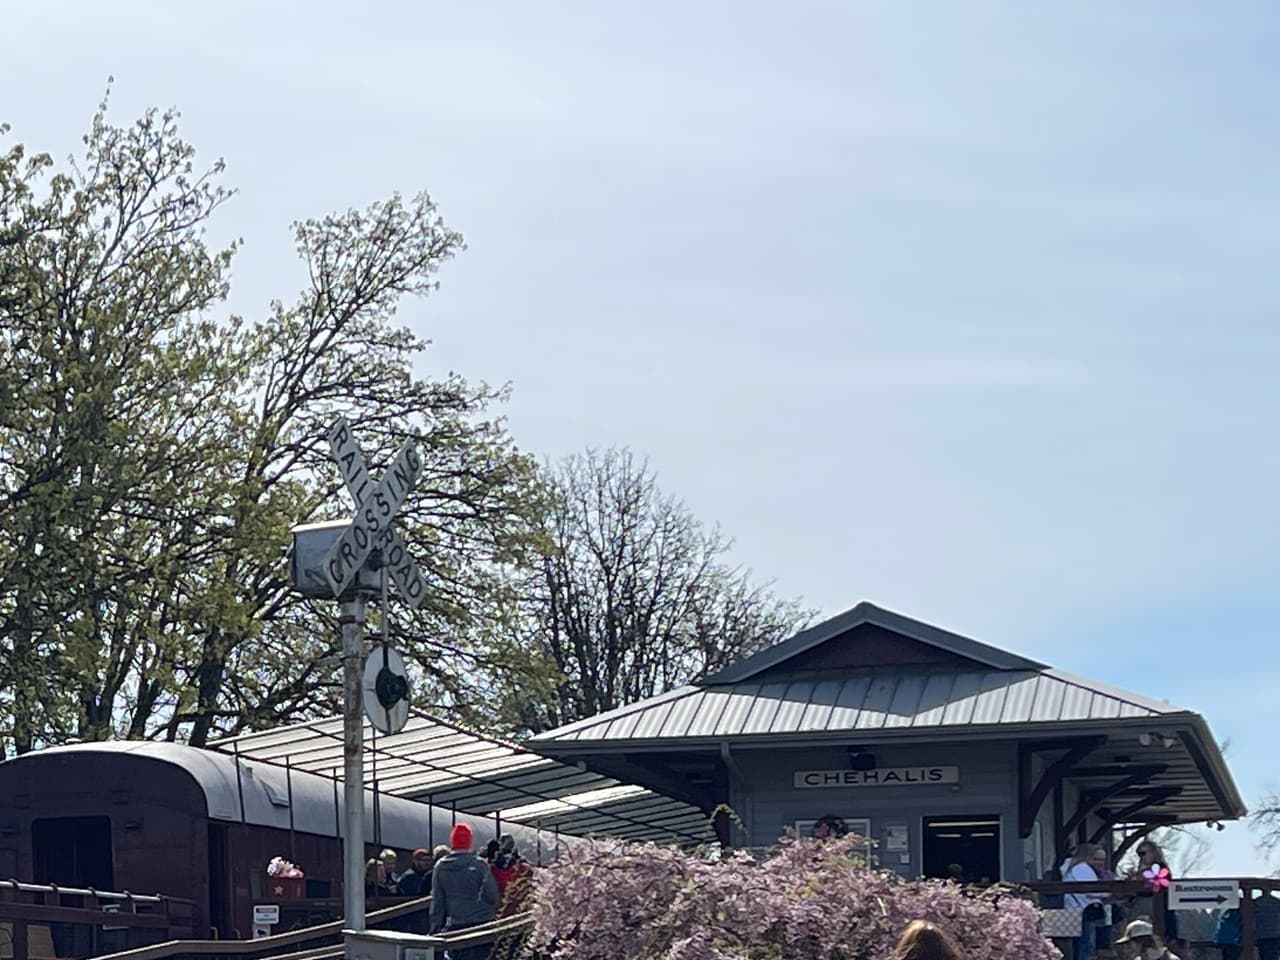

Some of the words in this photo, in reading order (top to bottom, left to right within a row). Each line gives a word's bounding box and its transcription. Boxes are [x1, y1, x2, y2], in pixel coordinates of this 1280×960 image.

[328, 449, 421, 585] CROSSING
[333, 424, 369, 506] RAIL
[378, 527, 421, 600] ROAD
[804, 768, 943, 785] CHEHALIS
